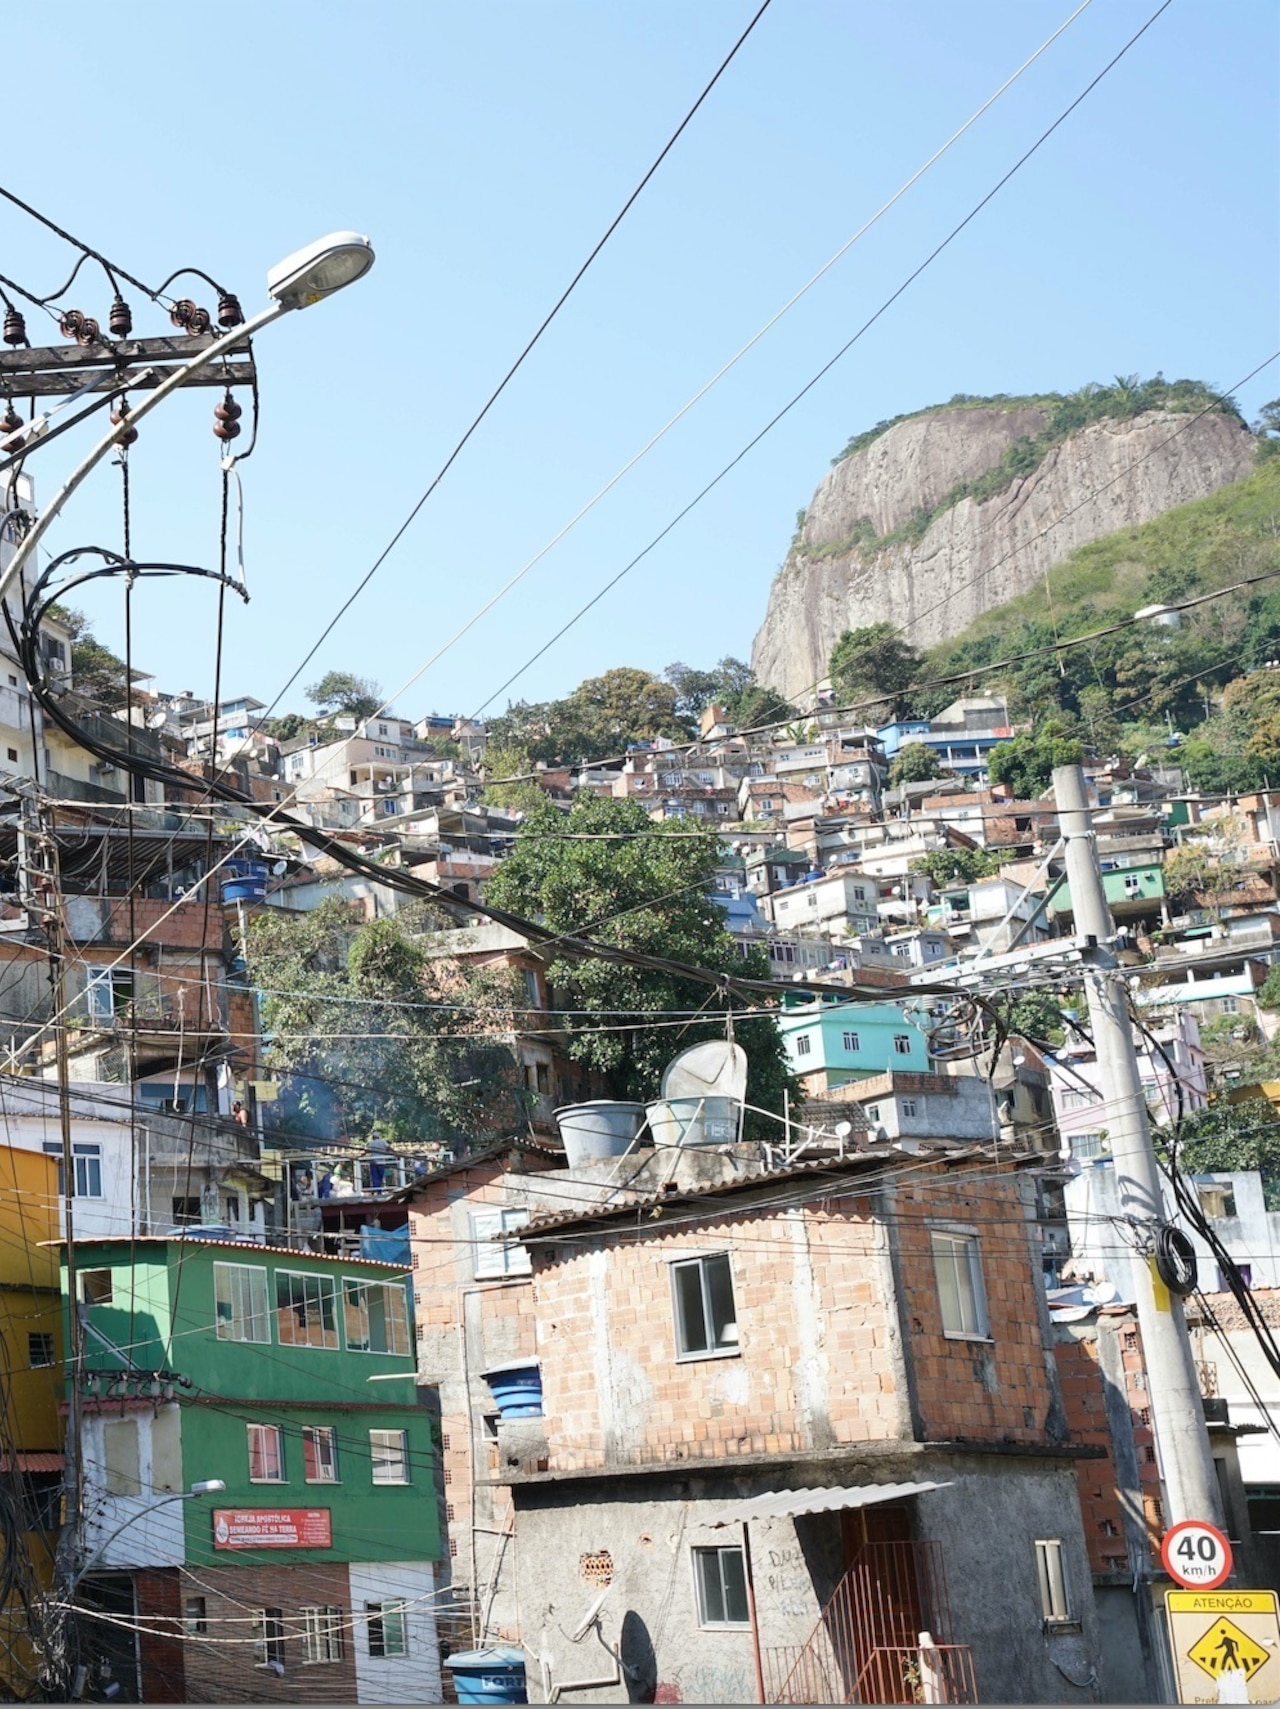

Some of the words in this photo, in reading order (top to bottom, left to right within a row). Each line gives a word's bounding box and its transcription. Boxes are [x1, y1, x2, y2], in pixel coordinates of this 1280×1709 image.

[234, 1515, 255, 1523] IGREJA
[256, 1513, 291, 1523] APOSTÓLICA
[229, 1526, 261, 1534] SEMEANDO
[279, 1525, 297, 1533] TERRA
[1177, 1535, 1216, 1562] 40
[1182, 1564, 1217, 1577] km/h
[1193, 1594, 1253, 1611] ATENÇÃO
